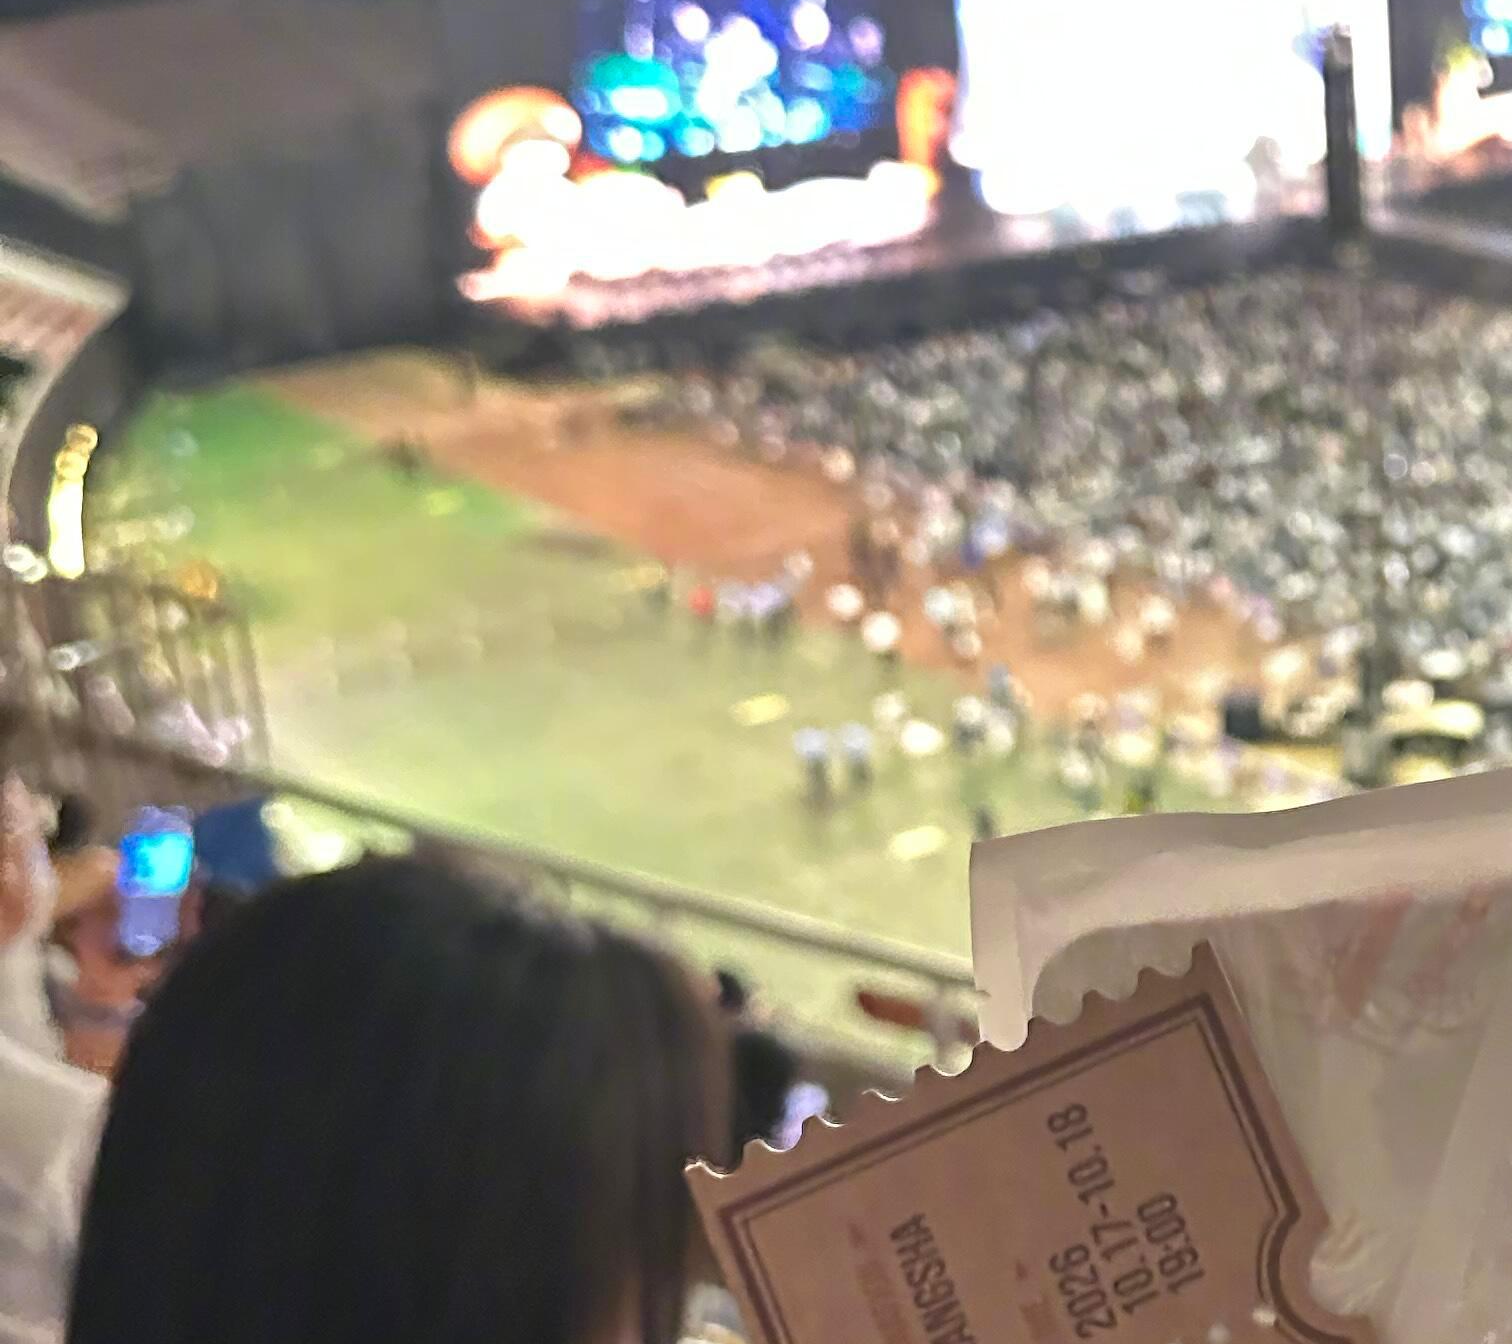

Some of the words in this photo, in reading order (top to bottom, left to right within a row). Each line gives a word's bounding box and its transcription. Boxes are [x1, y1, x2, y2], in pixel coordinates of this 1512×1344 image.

[1047, 1102, 1160, 1316] 10.17-10.18
[1136, 1192, 1206, 1296] 19:00
[1049, 1243, 1118, 1339] 2026
